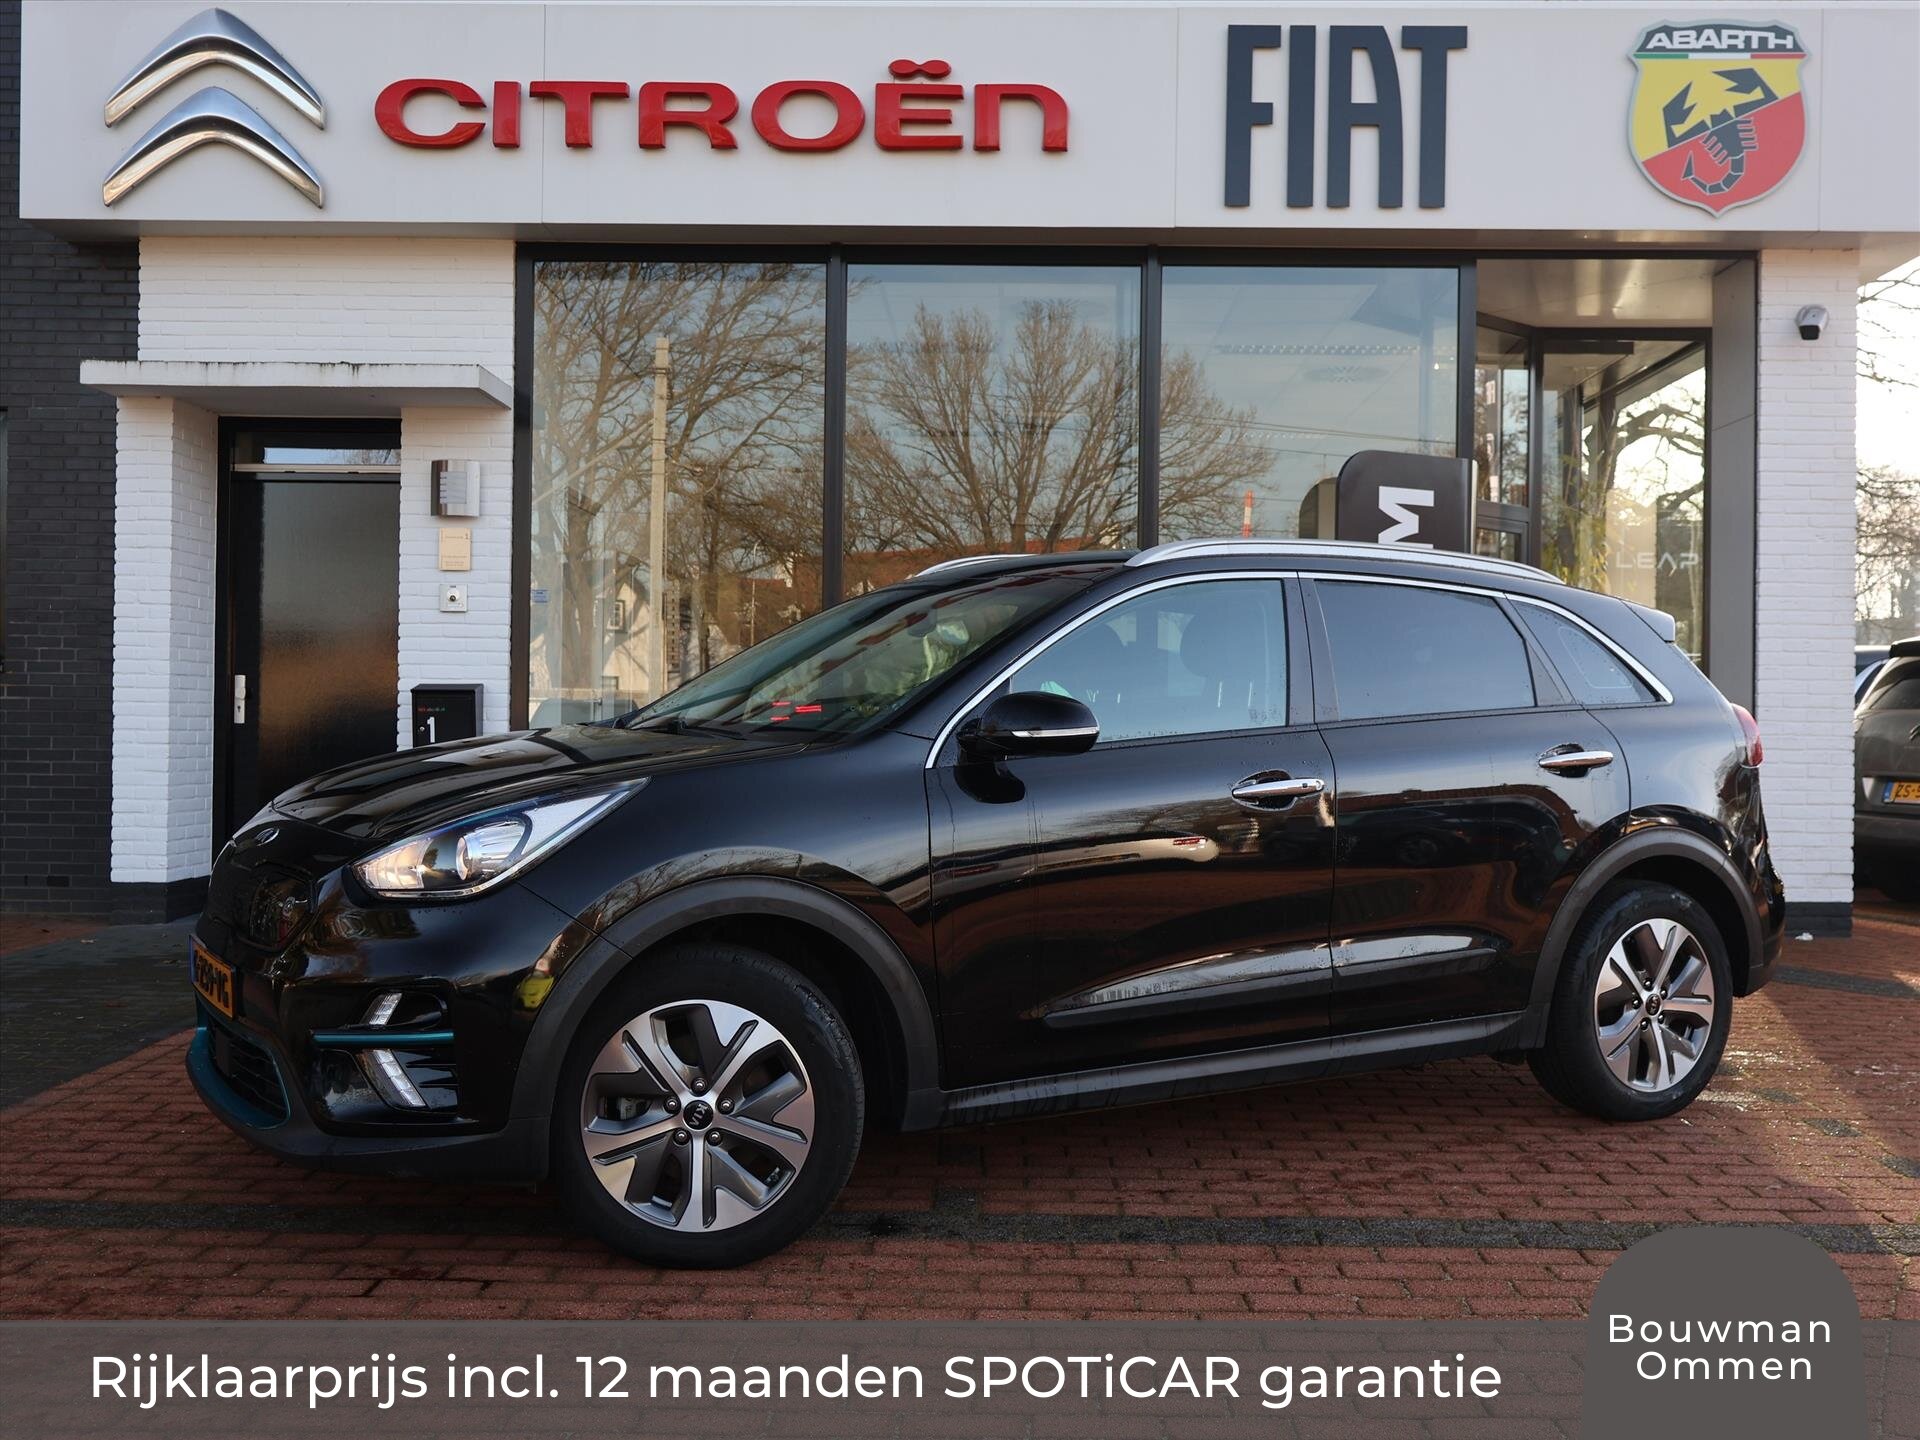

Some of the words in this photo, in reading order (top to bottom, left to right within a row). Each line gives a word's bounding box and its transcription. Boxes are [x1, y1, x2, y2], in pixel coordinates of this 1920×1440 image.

[1646, 29, 1794, 49] ABARTH
[375, 58, 1070, 153] CITROËN
[1225, 25, 1468, 210] FIAT
[427, 716, 436, 743] 1
